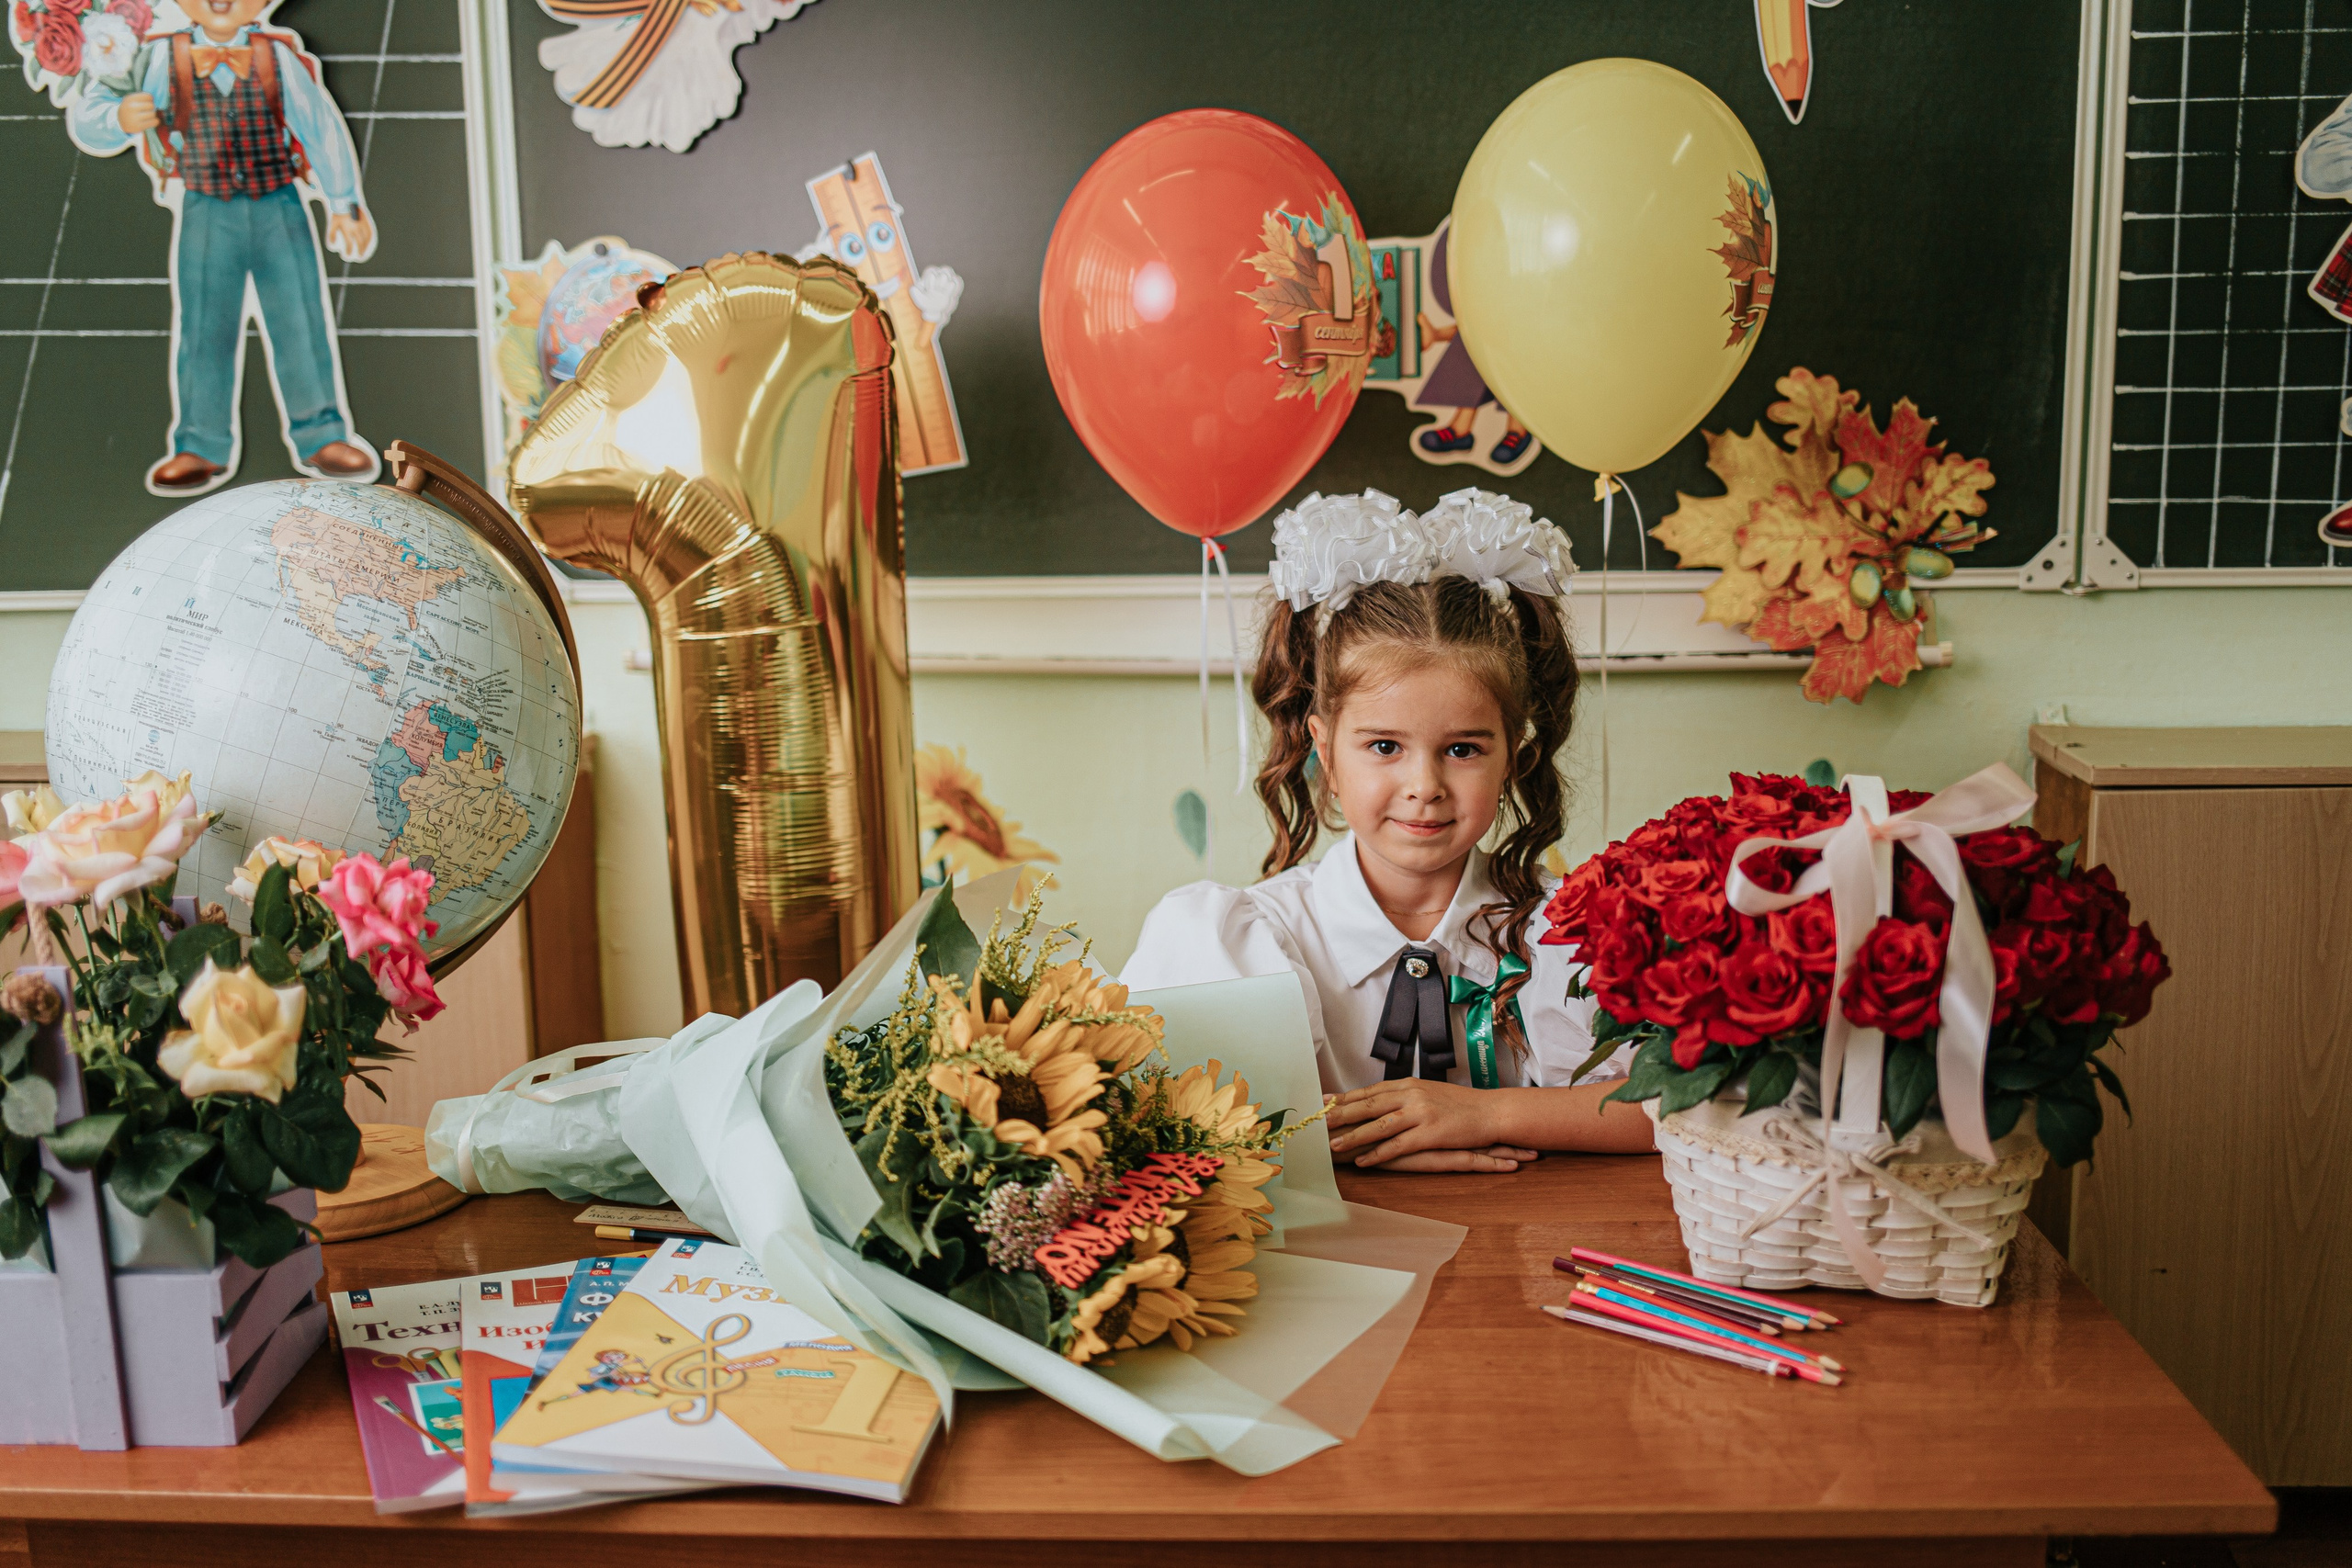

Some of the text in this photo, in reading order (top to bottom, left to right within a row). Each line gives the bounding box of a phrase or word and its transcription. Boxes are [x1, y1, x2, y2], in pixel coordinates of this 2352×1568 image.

[1317, 233, 1353, 320] 1
[332, 523, 404, 551] СОЕДИНЕННЫЕ
[310, 548, 401, 584] ШТАТЫ АМЕРИКИ
[187, 610, 209, 621] МИР
[356, 603, 401, 623] Мексиканский
[425, 610, 462, 627] САРГАССОВО
[465, 626, 480, 635] МОРЕ
[166, 615, 223, 635] политический глобус
[167, 626, 187, 634] Масштаб
[283, 617, 323, 636] МЕКСИКА
[406, 671, 459, 694] КАРИБСКОЕ МОРЕ
[434, 712, 471, 730] ВЕНЕСУЭЛА
[356, 736, 379, 747] ЭКВАДОР
[412, 734, 444, 749] КОЛУМБИЯ
[382, 796, 407, 808] ПЕРУ
[407, 821, 438, 835] БОЛИВИЯ
[438, 817, 501, 844] БРАЗИЛИЯ
[659, 1274, 792, 1304] Муз
[580, 1292, 615, 1306] Ф
[788, 1341, 854, 1351] МЕЛОДИЯ
[790, 1359, 901, 1444] 1
